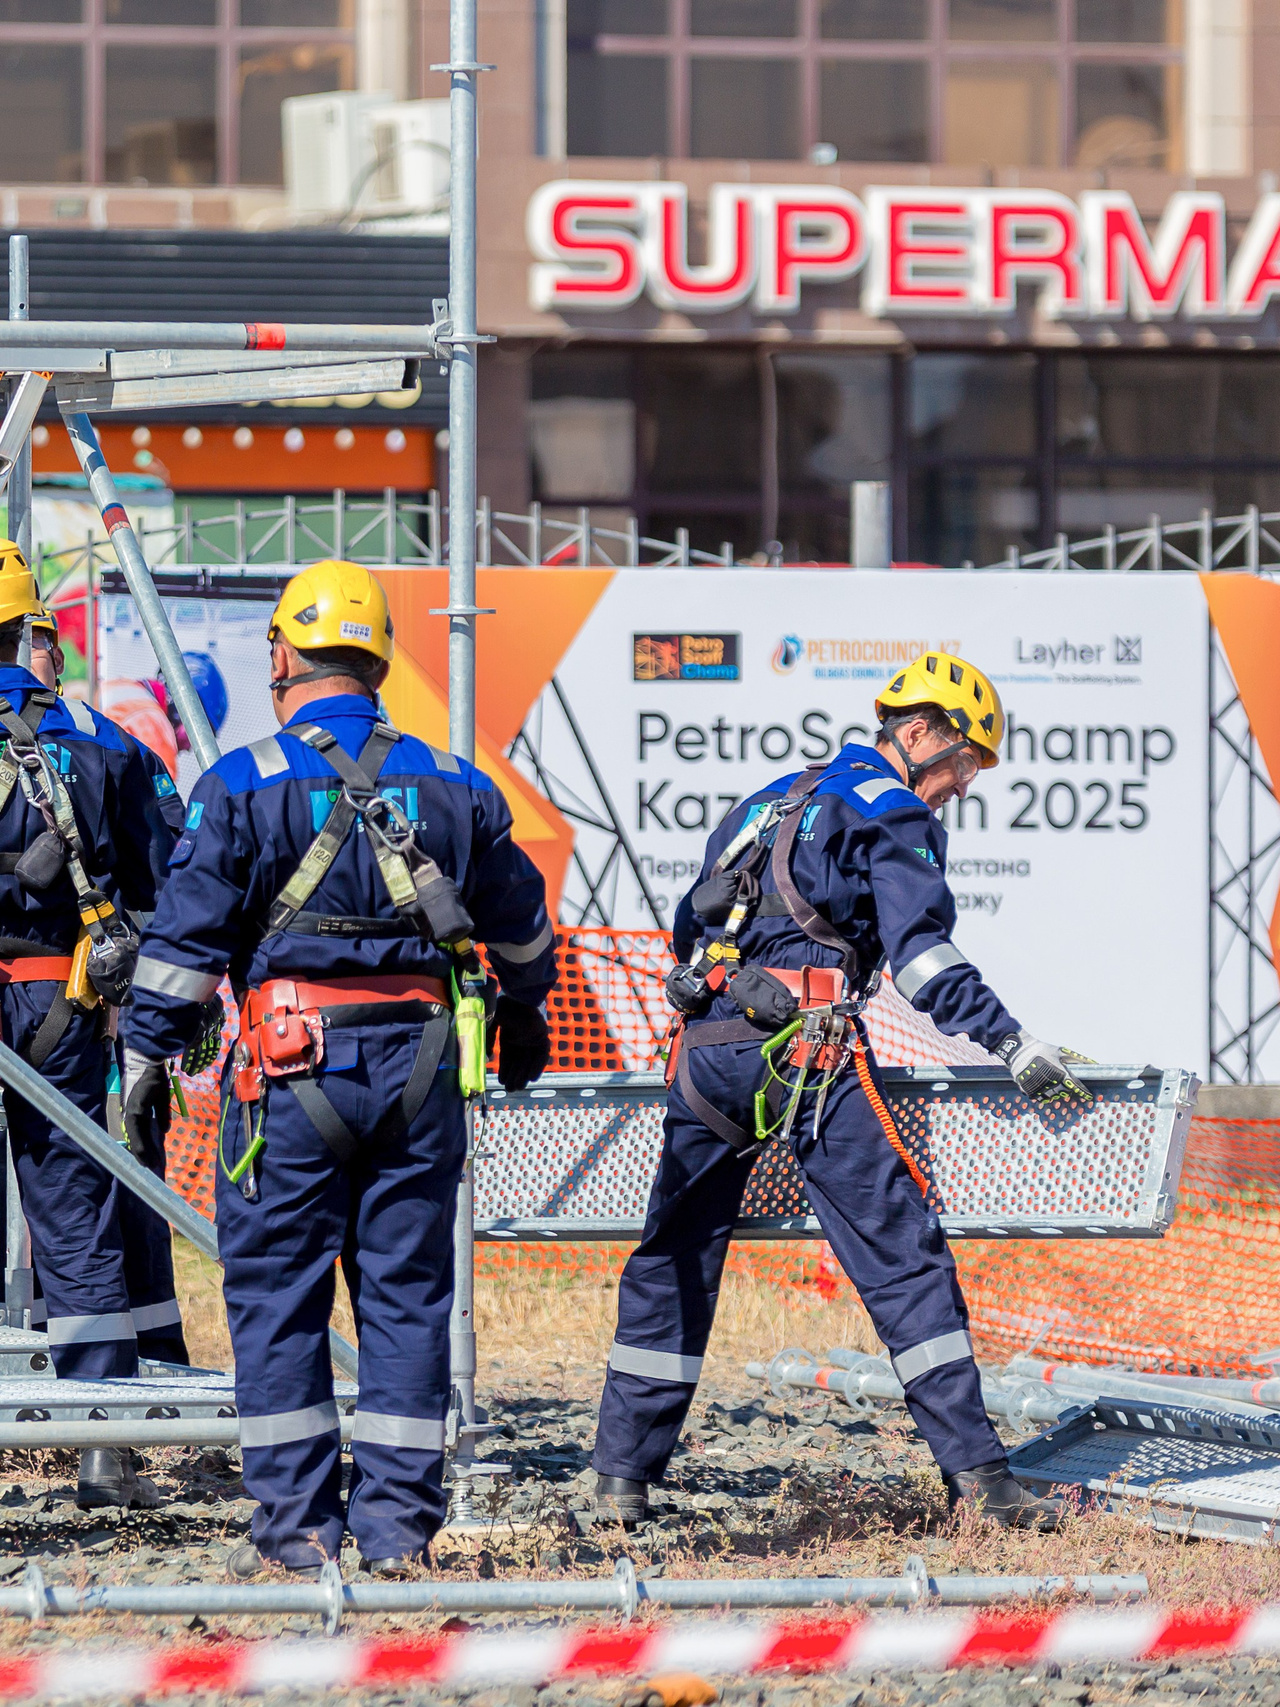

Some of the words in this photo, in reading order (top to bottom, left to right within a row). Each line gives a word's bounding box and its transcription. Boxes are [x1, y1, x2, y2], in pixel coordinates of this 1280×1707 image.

[1016, 637, 1104, 669] Layher
[1009, 781, 1150, 830] 2025
[639, 855, 700, 881] Перв
[947, 859, 1031, 875] хстана
